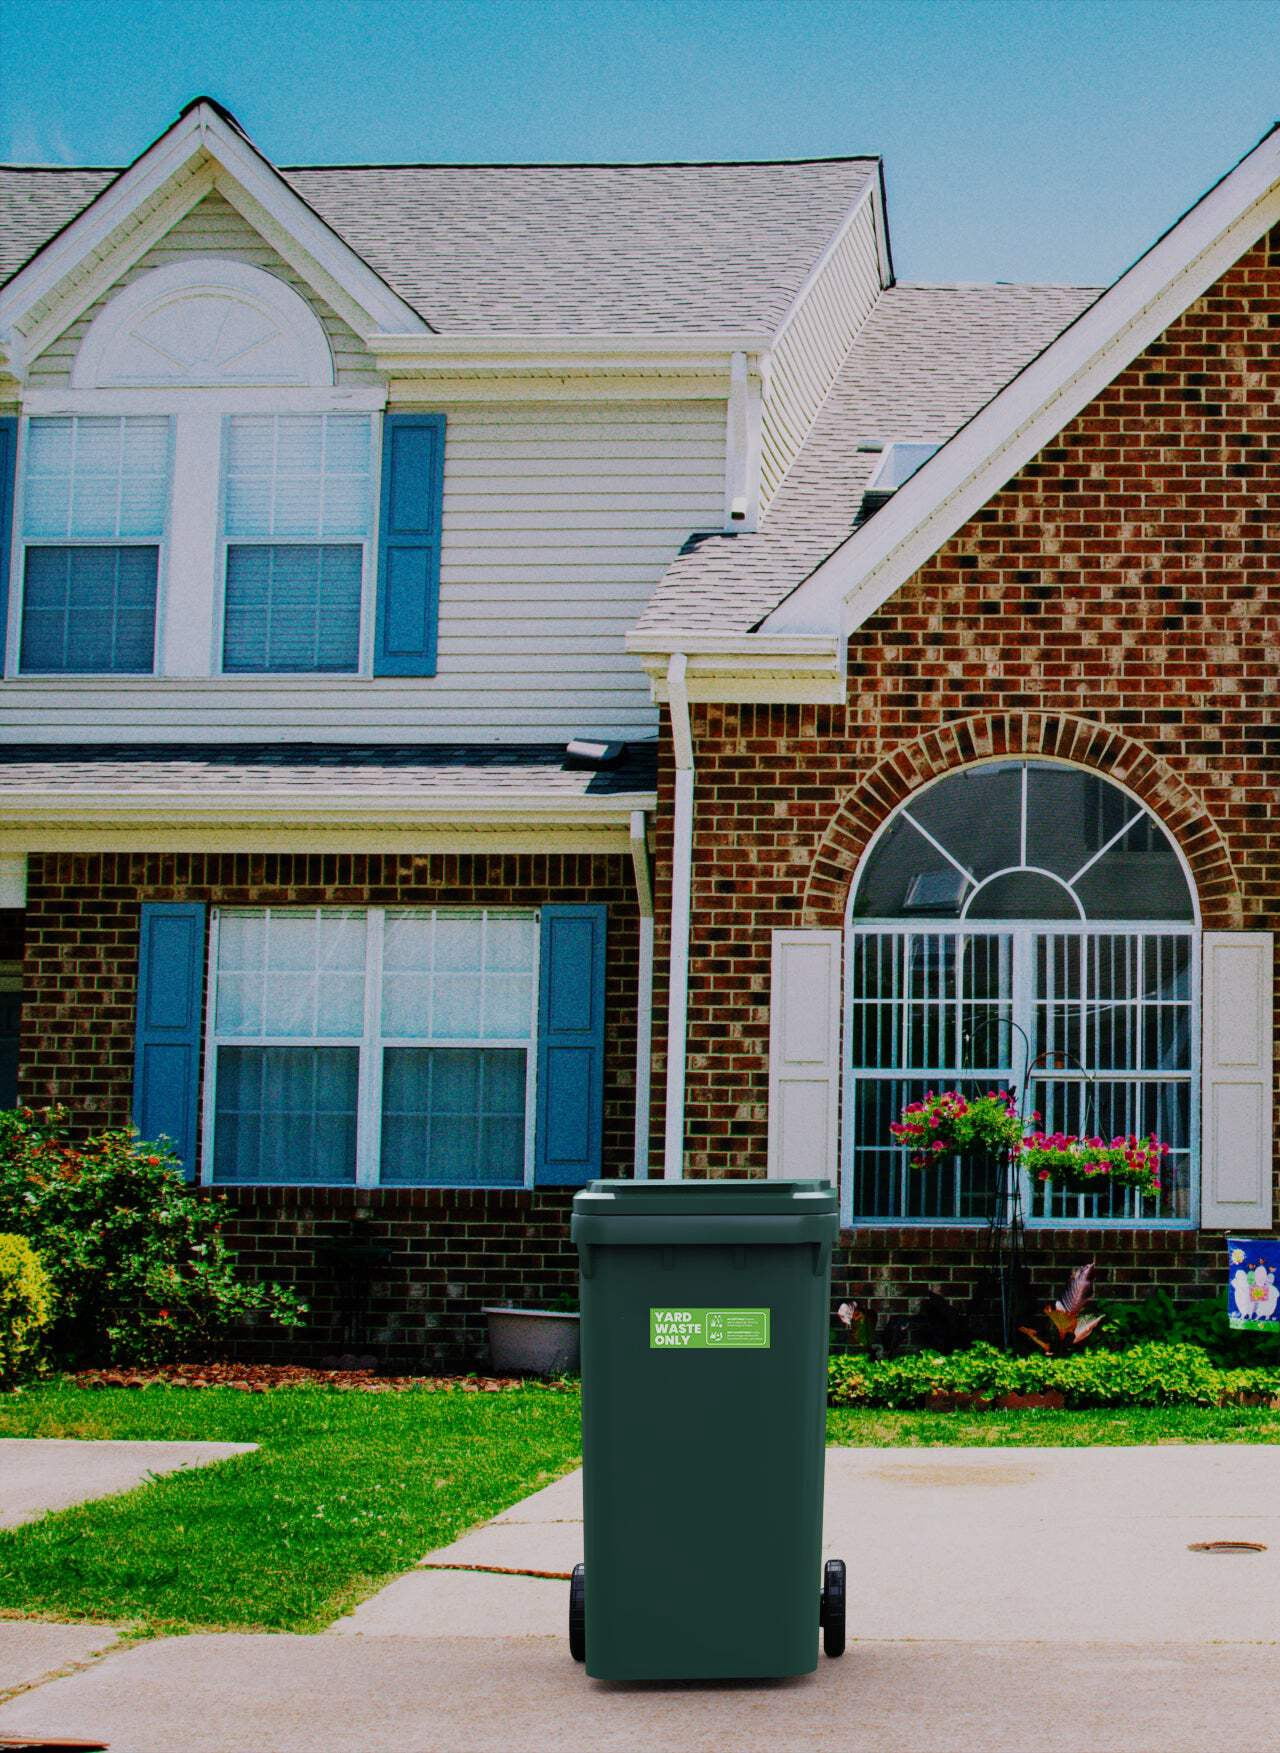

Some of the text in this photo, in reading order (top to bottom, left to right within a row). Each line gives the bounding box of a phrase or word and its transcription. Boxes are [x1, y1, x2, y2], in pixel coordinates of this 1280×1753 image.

[655, 1312, 692, 1322] YARD
[655, 1324, 702, 1334] WASTE
[655, 1335, 691, 1345] ONLY
